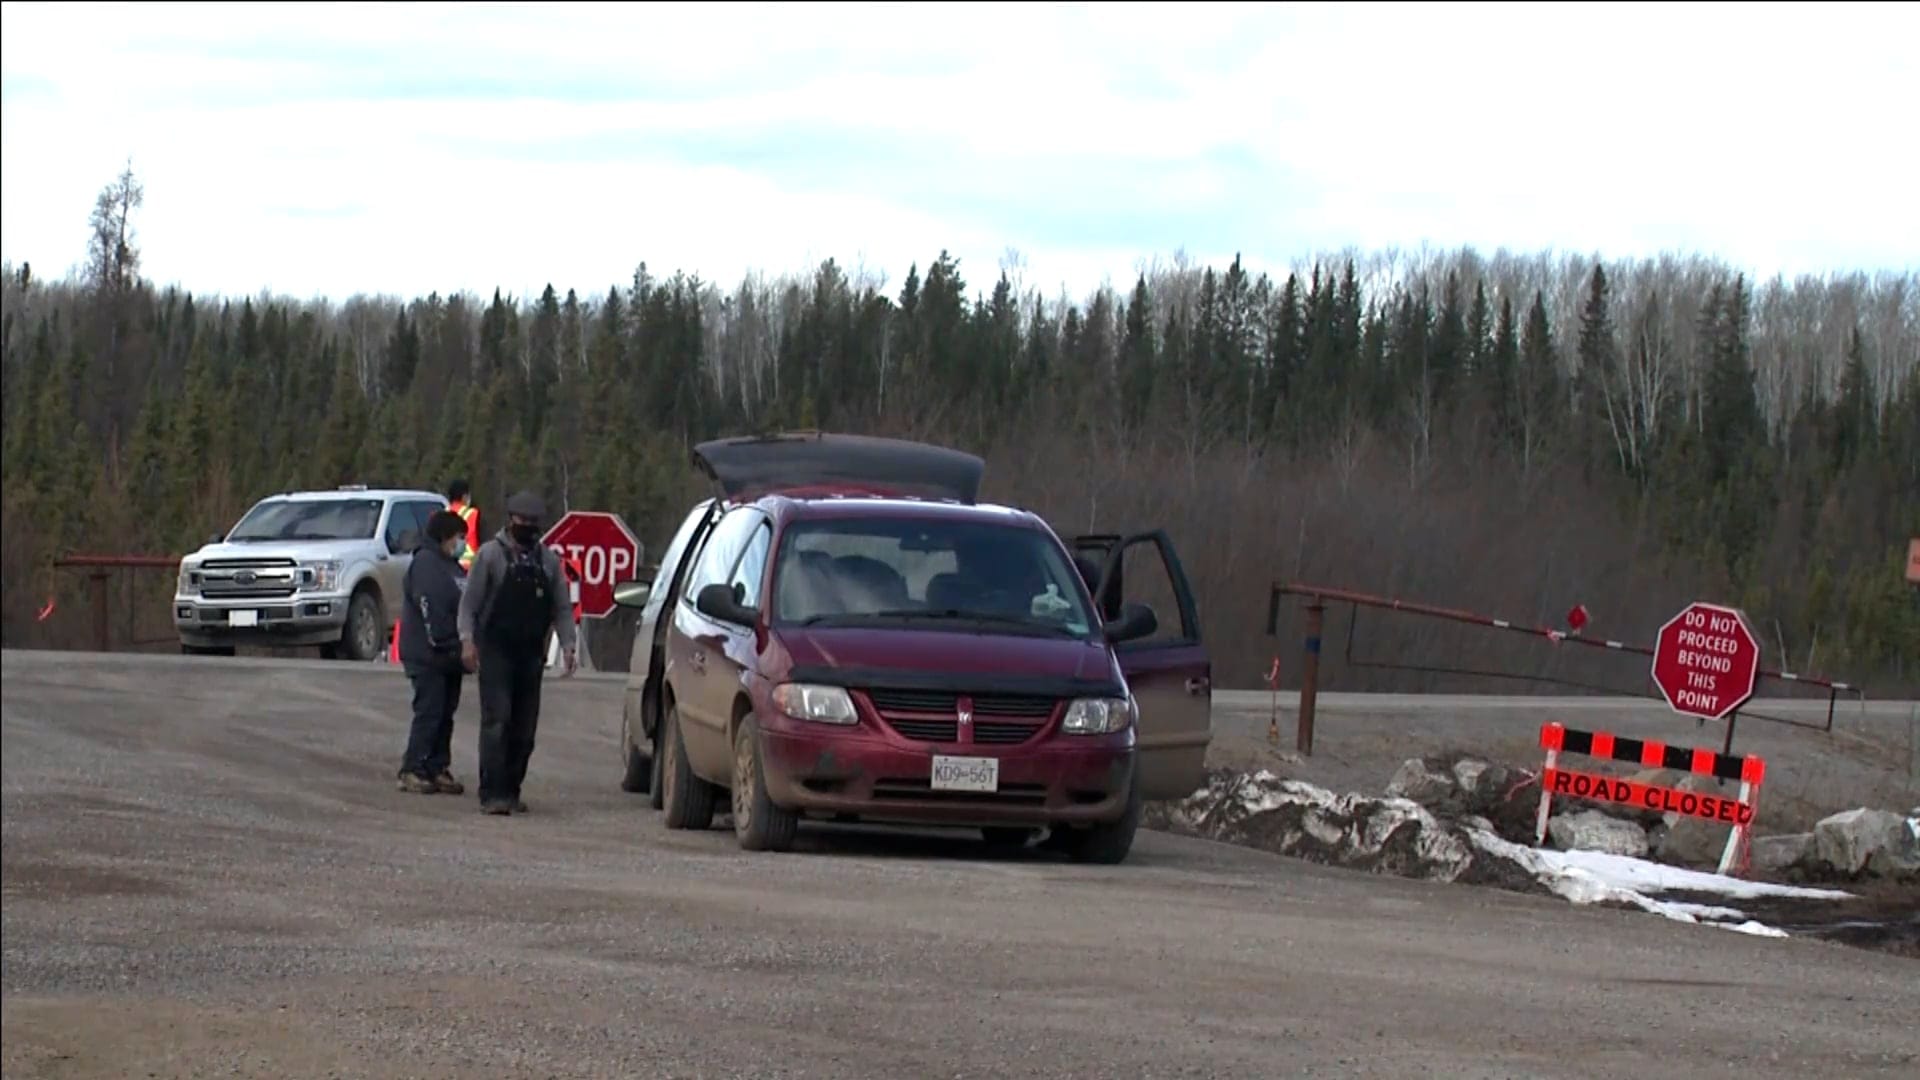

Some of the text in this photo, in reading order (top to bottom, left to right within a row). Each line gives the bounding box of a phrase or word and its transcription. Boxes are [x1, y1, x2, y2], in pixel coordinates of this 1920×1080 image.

[1685, 611, 1738, 634] DO NOT
[1678, 629, 1738, 655] PROCEED
[1678, 649, 1731, 673] BEYOND
[1687, 671, 1717, 691] THIS
[1677, 689, 1719, 711] POINT
[1554, 771, 1752, 825] ROAD CLOSED
